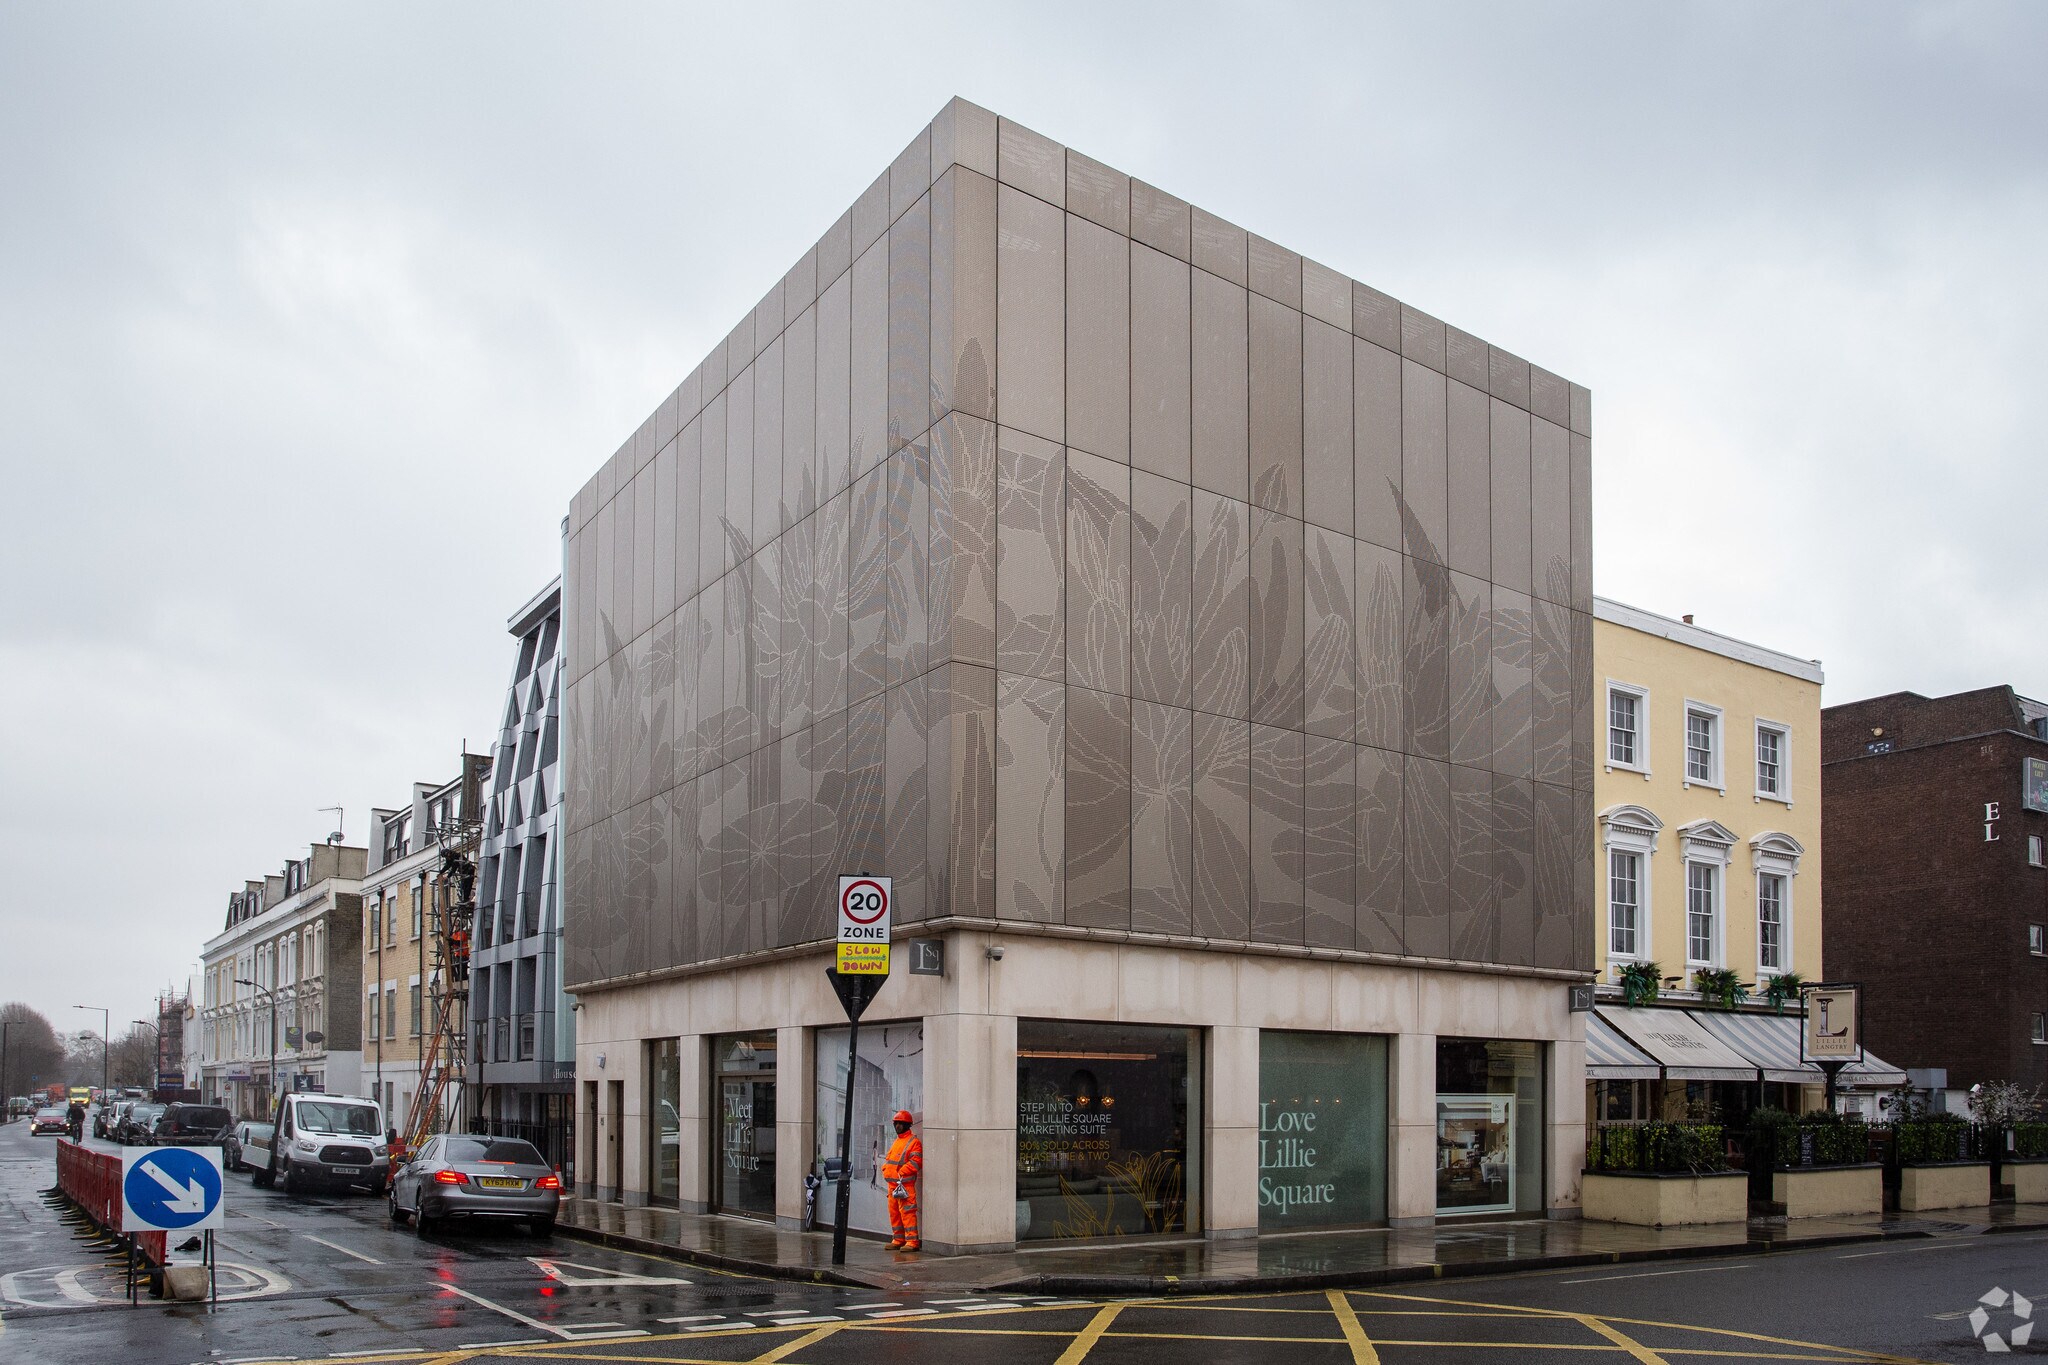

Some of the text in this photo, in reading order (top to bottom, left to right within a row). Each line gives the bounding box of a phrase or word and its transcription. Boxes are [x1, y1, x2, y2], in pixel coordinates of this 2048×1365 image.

[850, 893, 881, 911] 20
[843, 927, 884, 938] ZONE
[845, 945, 881, 955] SLOW
[842, 961, 883, 971] DOWN
[728, 1097, 752, 1119] Meet
[1020, 1102, 1045, 1112] STEP
[1020, 1113, 1112, 1124] THE LILLIE SQUARE
[1259, 1102, 1316, 1132] Love
[728, 1121, 751, 1144] Lilie
[1020, 1125, 1106, 1135] MARKETING SUITE
[1020, 1140, 1110, 1151] 90% SOLD ACROSS
[1078, 1152, 1085, 1161] &
[1088, 1151, 1110, 1161] TWO
[1259, 1138, 1316, 1168] Lillie
[1258, 1176, 1335, 1215] Square
